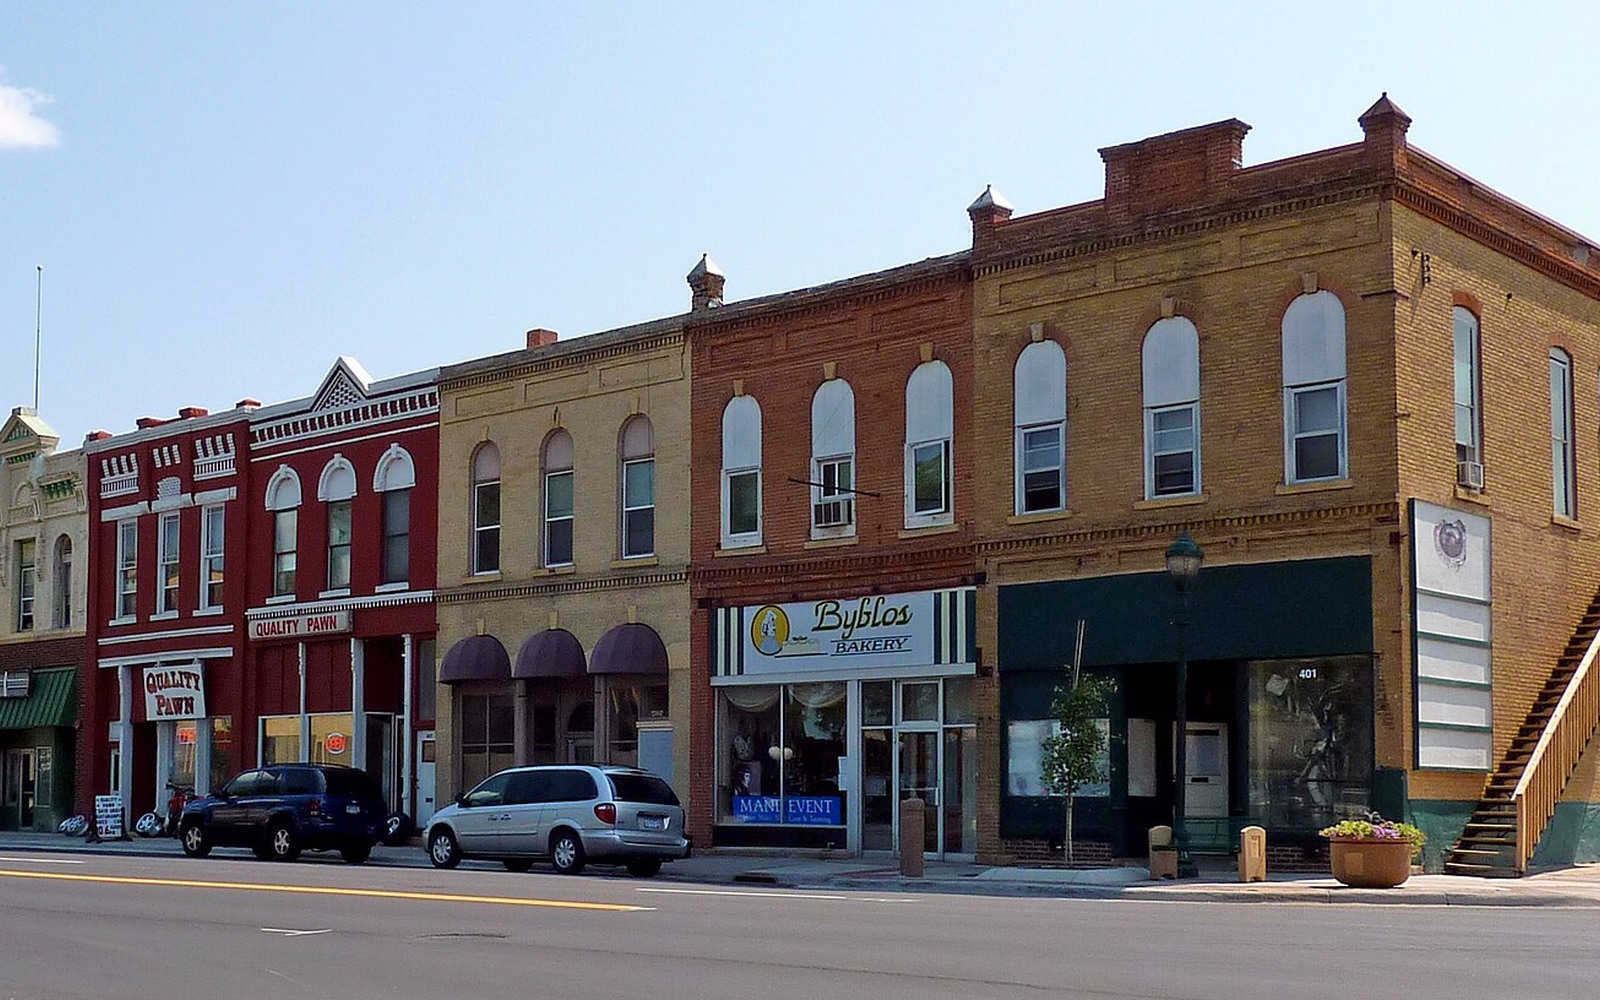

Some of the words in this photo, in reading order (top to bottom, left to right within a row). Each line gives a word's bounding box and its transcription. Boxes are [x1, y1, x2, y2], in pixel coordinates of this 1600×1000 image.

[256, 619, 300, 637] QUALITY
[306, 615, 337, 632] PAWN
[811, 597, 913, 639] Byblos
[835, 638, 909, 654] BAKERY
[146, 671, 201, 693] QUALITY
[1299, 668, 1317, 679] 401
[155, 694, 195, 716] PAWN
[788, 799, 833, 813] EVENT
